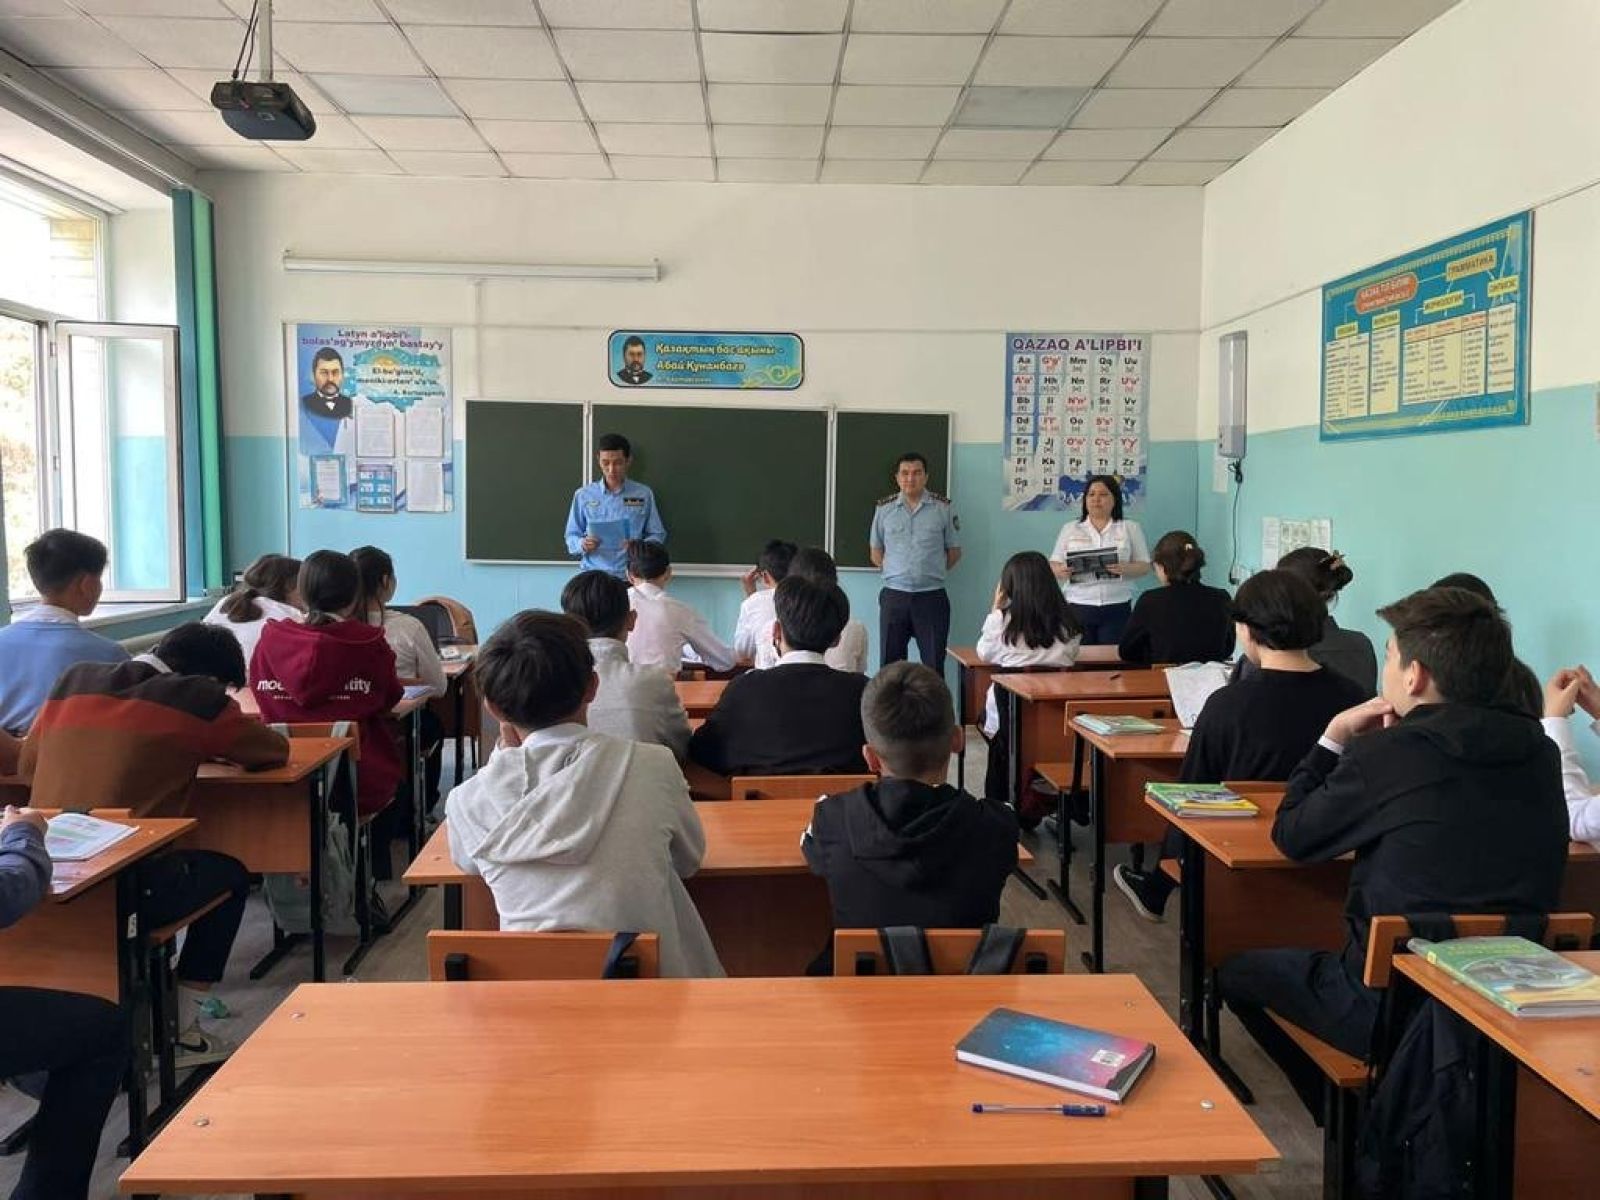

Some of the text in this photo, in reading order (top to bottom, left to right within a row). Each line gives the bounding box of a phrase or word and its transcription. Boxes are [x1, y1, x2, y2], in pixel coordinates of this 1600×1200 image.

[337, 328, 368, 339] Latyn
[655, 343, 715, 355] Қазақтың
[717, 343, 735, 354] бас
[736, 345, 776, 356] ақыны
[1013, 338, 1142, 351] QAZAQ A'LIPBI'I
[656, 360, 685, 371] Абай
[1018, 356, 1031, 365] Aa
[1069, 357, 1087, 365] Mm
[1099, 357, 1112, 366] Qq
[1124, 357, 1138, 365] Uu
[1071, 376, 1085, 384] Nn
[1099, 377, 1111, 385] Rr
[1016, 396, 1030, 404] Bb
[1124, 397, 1137, 405] Vv
[1016, 416, 1029, 424] Dd
[1069, 416, 1084, 425] Oo
[1123, 417, 1137, 427] Yy
[1016, 437, 1029, 445] Ee
[1044, 437, 1054, 447] Jj
[1042, 457, 1055, 465] Kk
[1069, 458, 1082, 467] Pp
[1122, 458, 1135, 466] Zz
